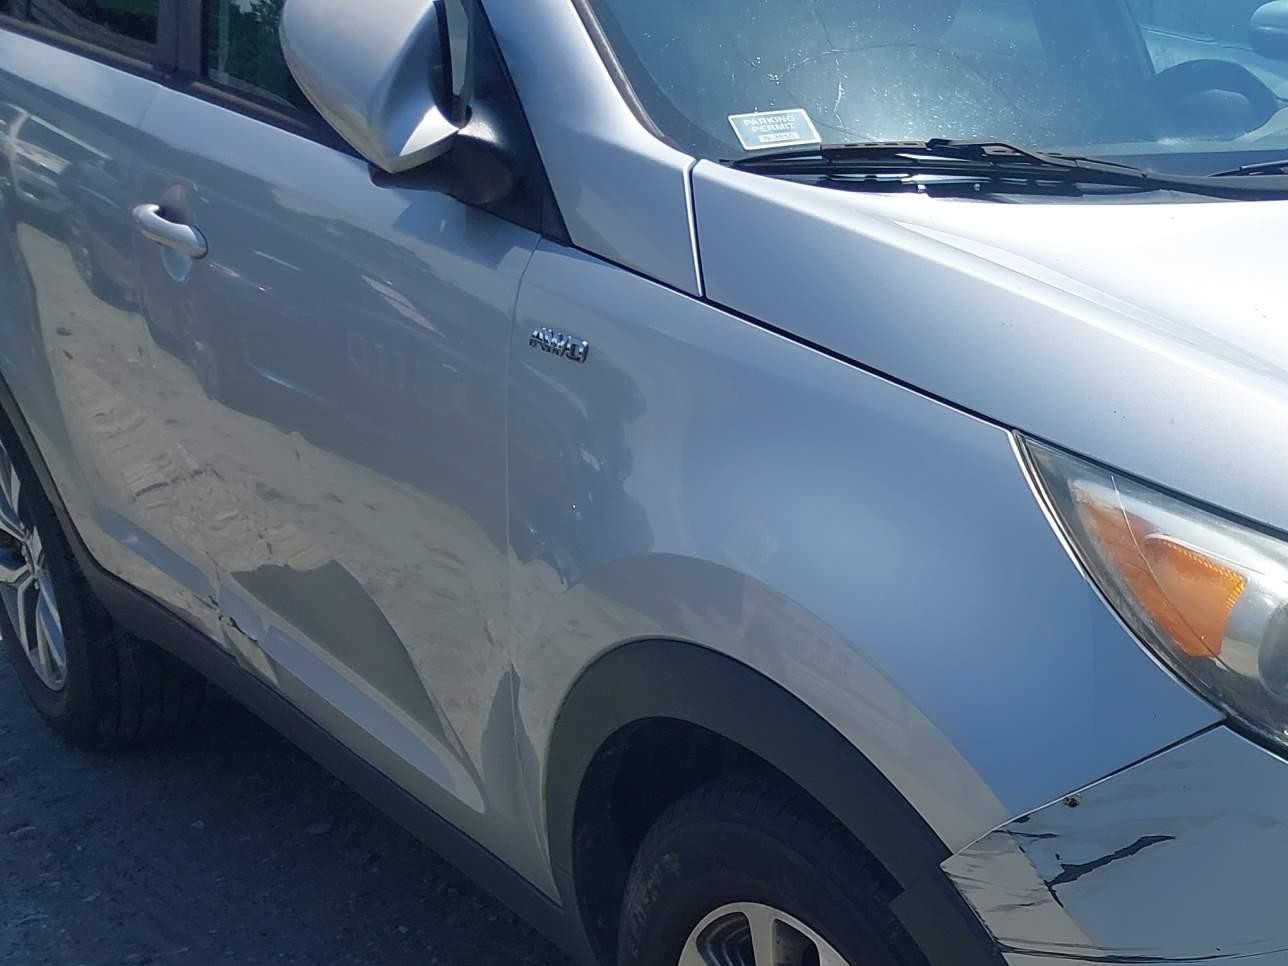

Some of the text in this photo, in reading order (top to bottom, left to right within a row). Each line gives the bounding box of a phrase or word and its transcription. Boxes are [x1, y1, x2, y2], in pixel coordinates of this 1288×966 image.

[743, 115, 796, 126] PARKING
[752, 122, 795, 133] PERMIT
[529, 327, 589, 363] AWD
